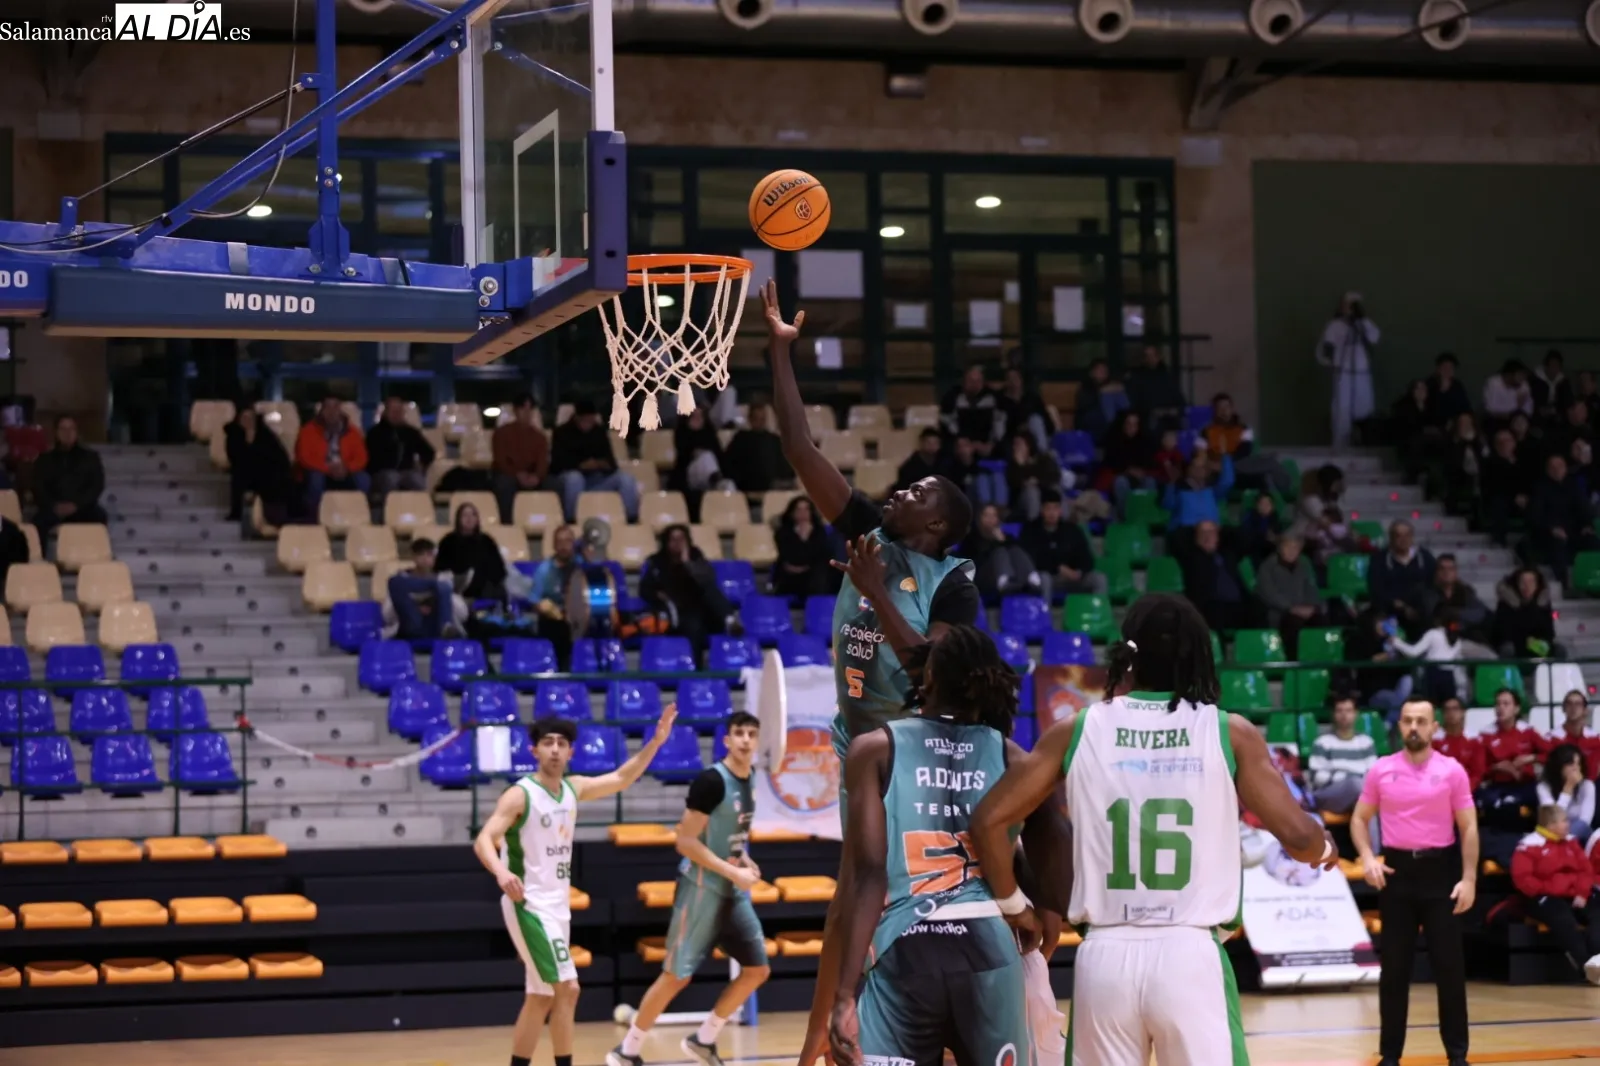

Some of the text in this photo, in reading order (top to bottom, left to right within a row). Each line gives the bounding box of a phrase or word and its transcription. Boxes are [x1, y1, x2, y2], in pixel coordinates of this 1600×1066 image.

[763, 176, 809, 206] Wilson
[225, 292, 315, 314] MONDO
[846, 642, 874, 660] salud
[845, 666, 865, 698] 5
[1127, 702, 1169, 711] GIVOV
[1115, 727, 1190, 750] RIVERA
[1106, 798, 1194, 891] 16
